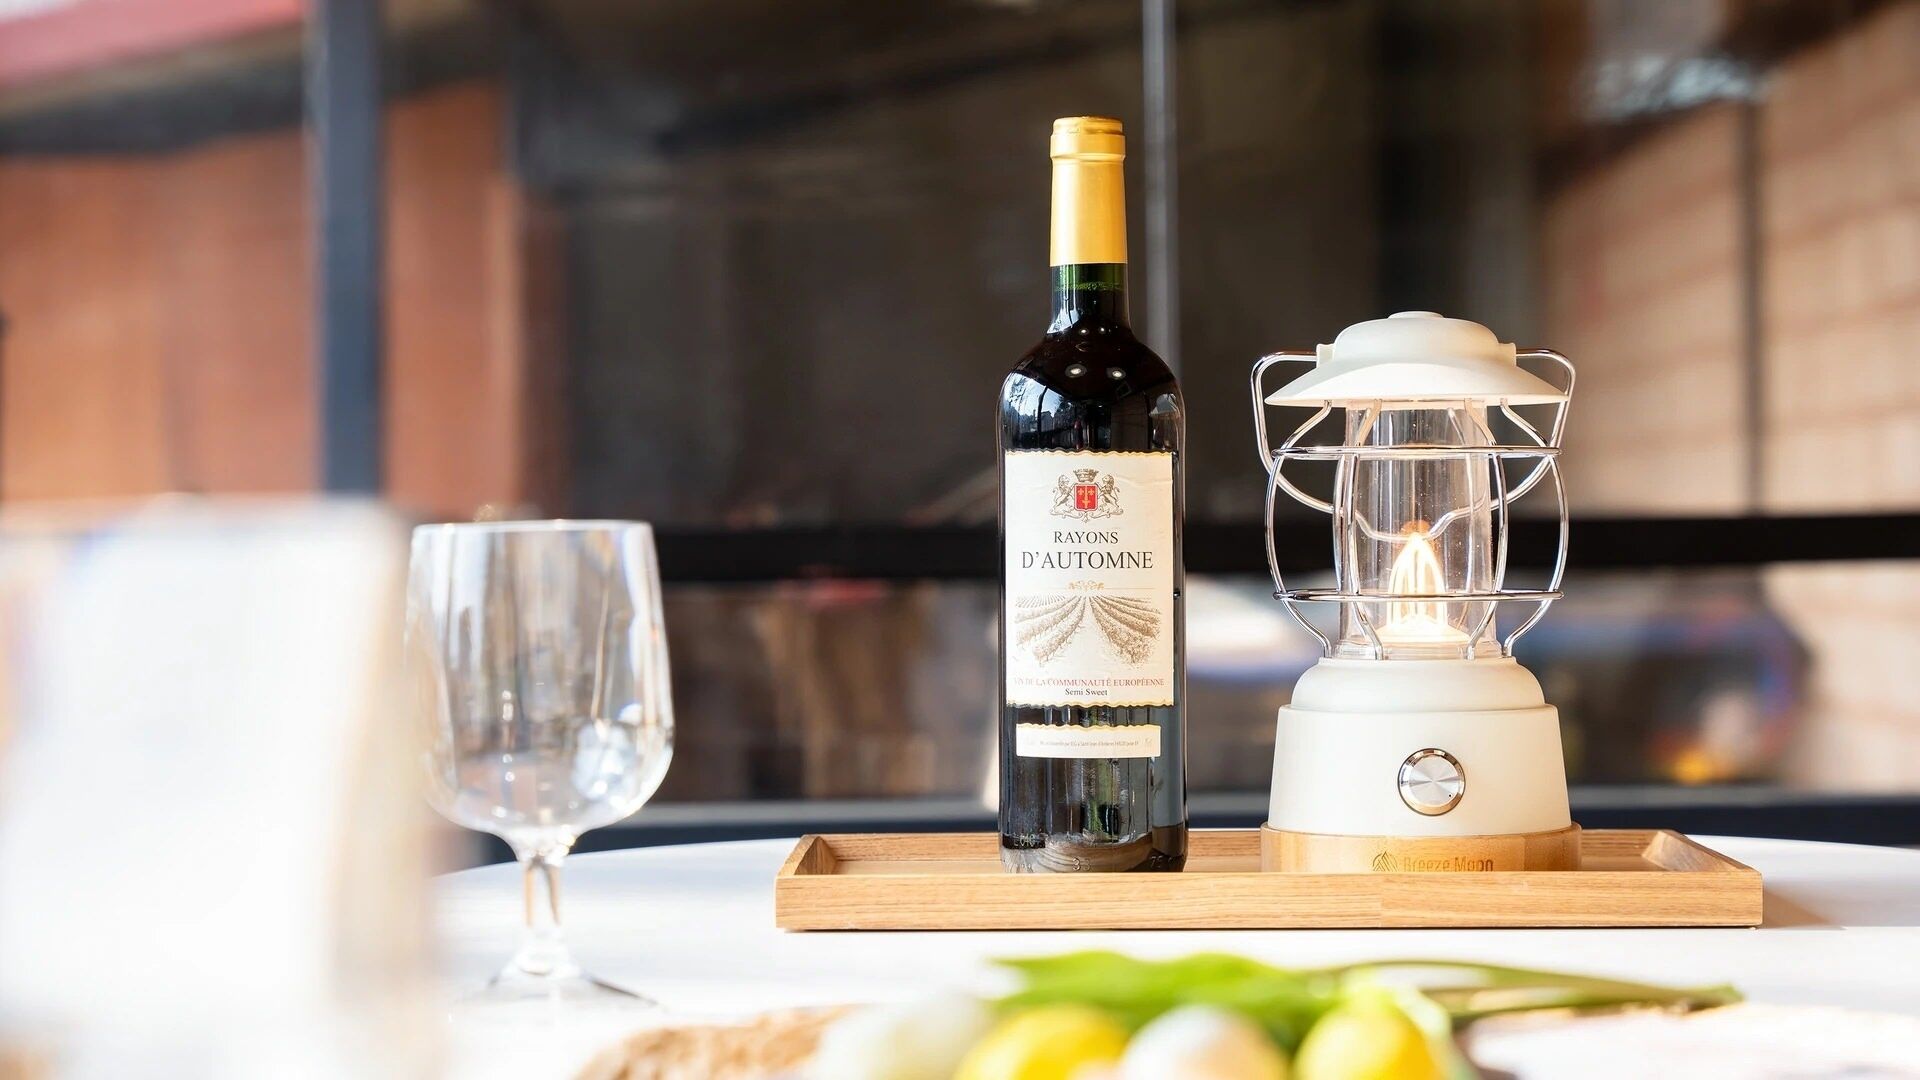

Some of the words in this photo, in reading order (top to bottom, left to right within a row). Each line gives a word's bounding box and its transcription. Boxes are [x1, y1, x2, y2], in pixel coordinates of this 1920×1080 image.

[1054, 531, 1118, 544] RAYONS
[1022, 551, 1153, 569] D’AUTOMNE
[1047, 677, 1112, 687] COMMUNAUTÉ
[1065, 688, 1084, 696] Semi
[1085, 688, 1108, 696] Sweet
[1403, 857, 1450, 872] Breeze
[1454, 856, 1494, 872] Moon
